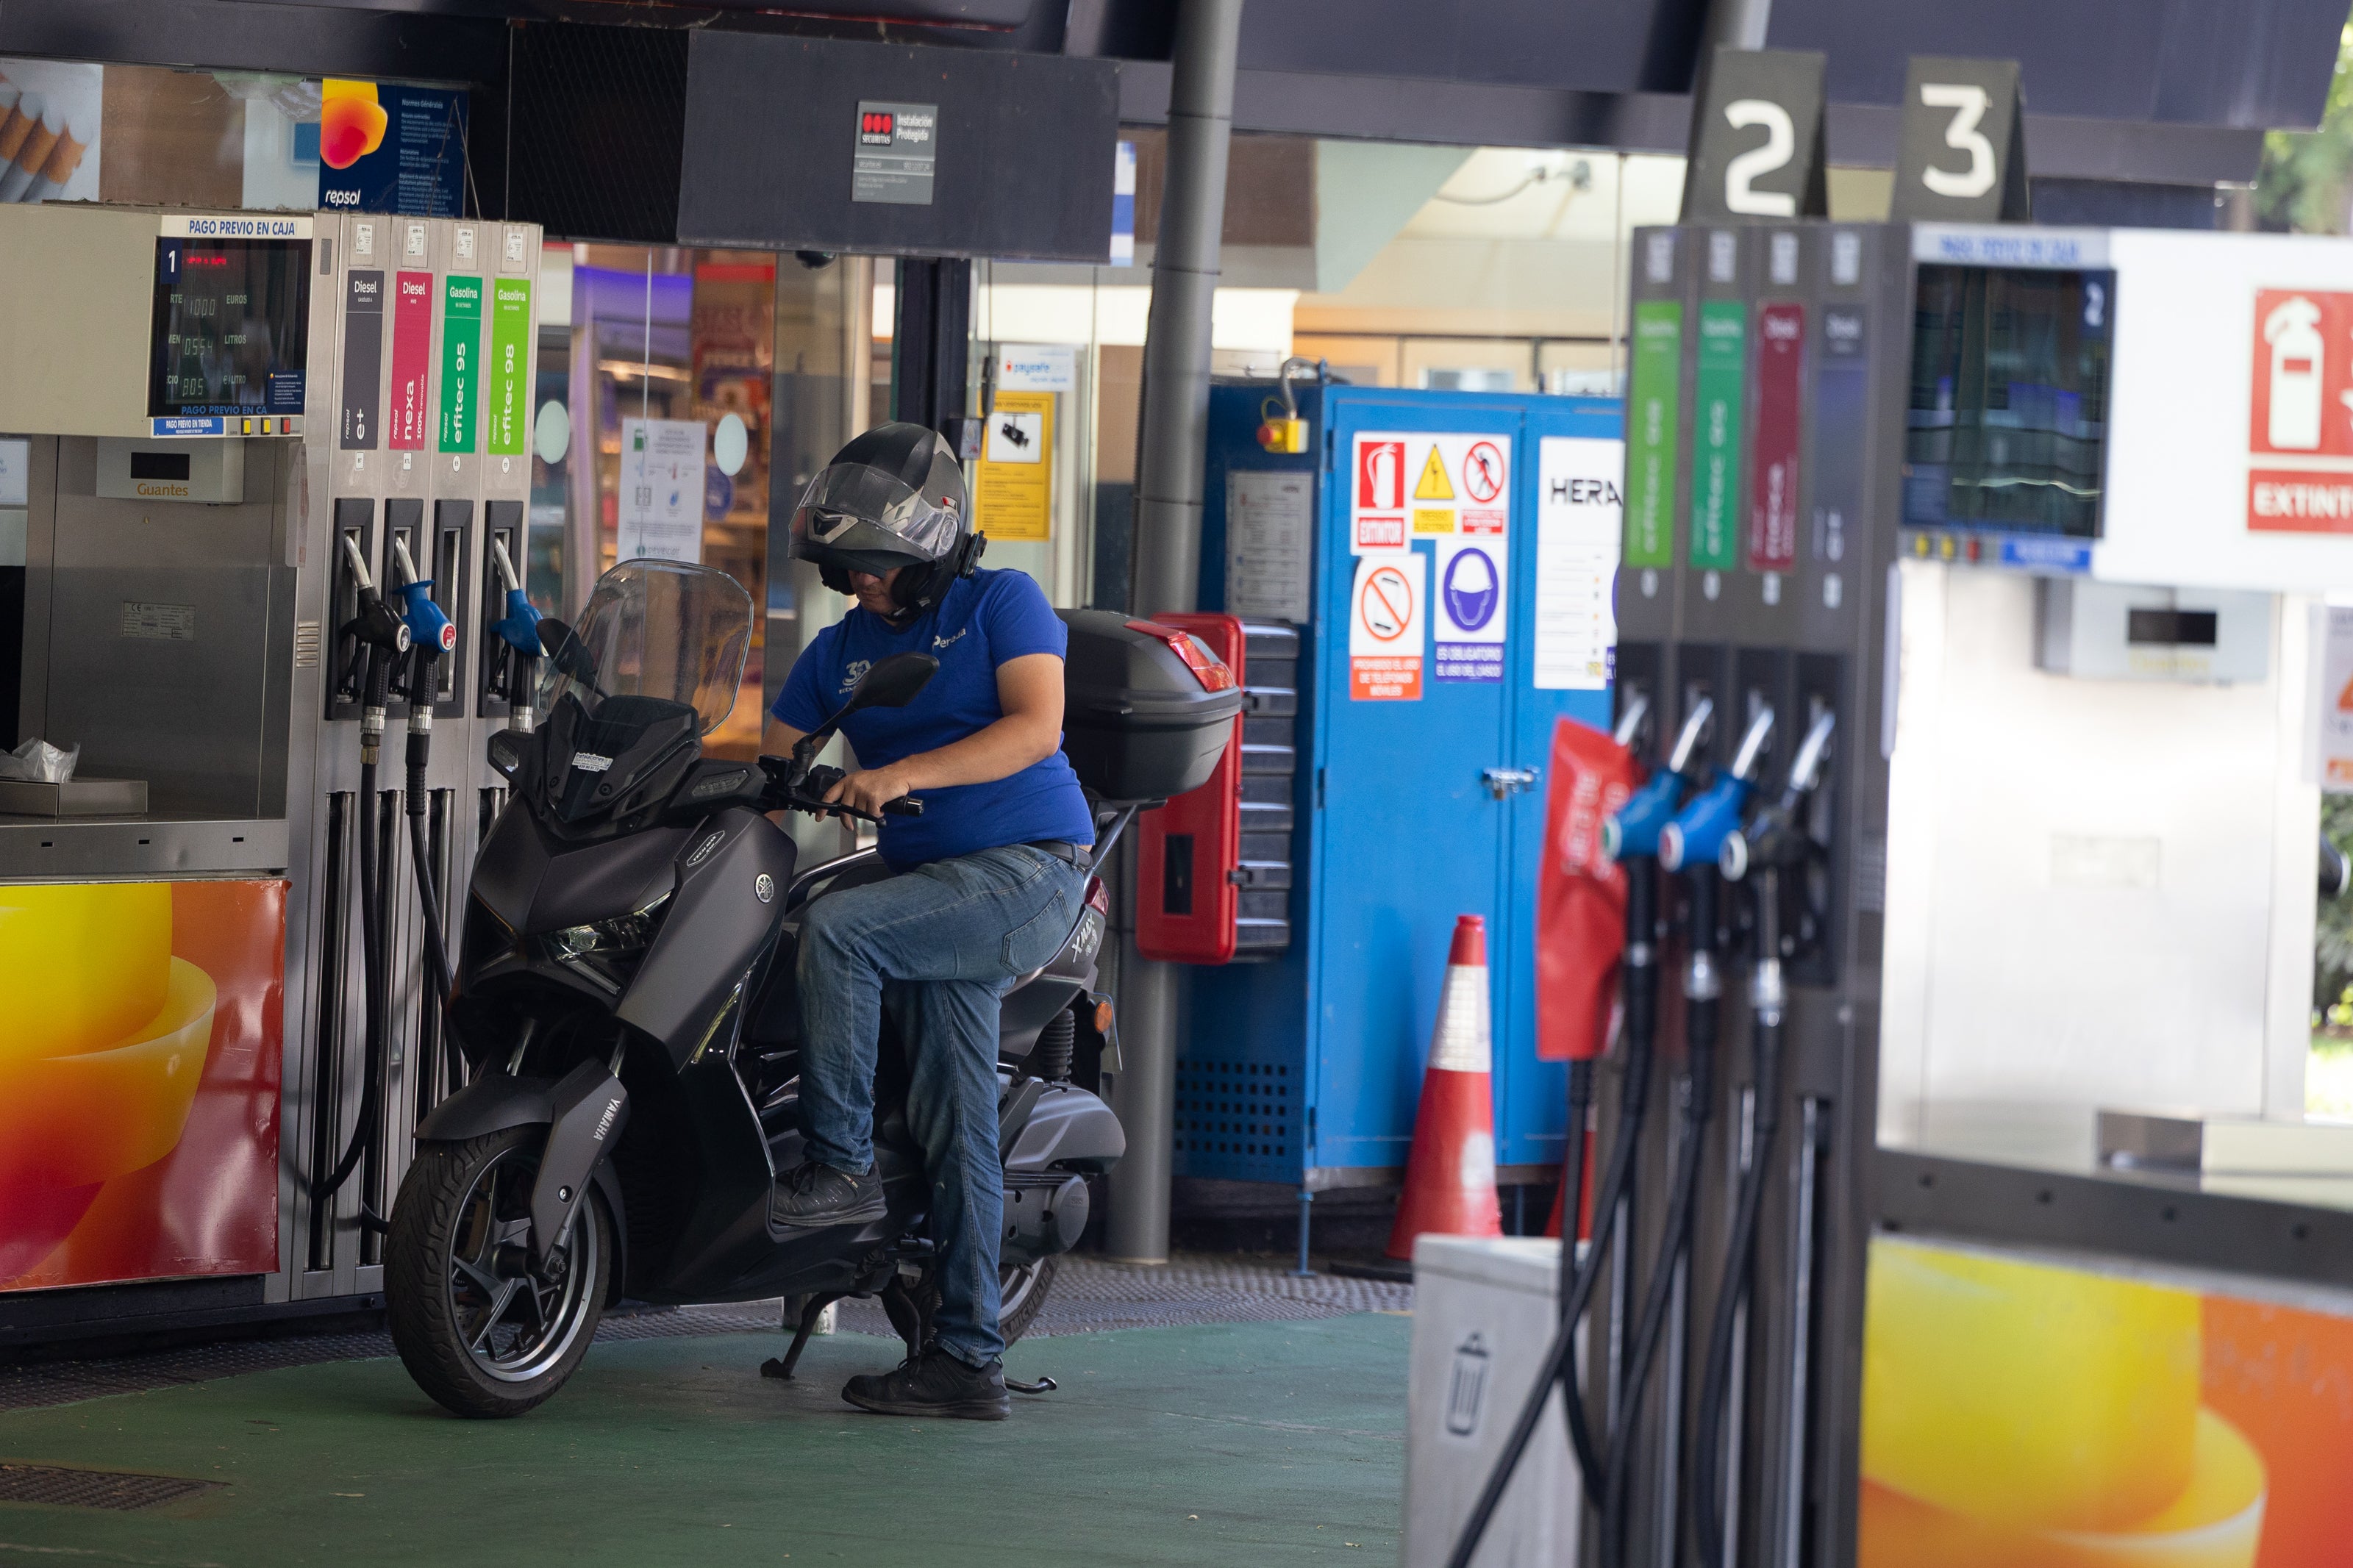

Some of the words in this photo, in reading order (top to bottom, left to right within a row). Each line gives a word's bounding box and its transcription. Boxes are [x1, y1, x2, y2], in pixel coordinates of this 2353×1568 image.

[862, 133, 892, 145] SECURITAS
[896, 126, 929, 143] Protegida
[1920, 82, 1996, 198] 3
[1724, 99, 1795, 218] 2
[325, 189, 361, 207] repsol
[189, 220, 216, 235] PAGO
[219, 221, 254, 235] PREVIO
[257, 222, 269, 235] EN
[272, 222, 295, 236] CAJA
[168, 250, 176, 273] 1
[354, 281, 376, 293] Diesel
[403, 282, 426, 296] Diesel
[449, 286, 478, 299] Gasolina
[498, 289, 526, 302] Gasolina
[226, 295, 248, 305] EUROS
[2085, 281, 2104, 326] 2
[224, 335, 247, 345] LITROS
[456, 343, 466, 371] 95
[505, 343, 515, 373] 98
[182, 406, 206, 415] PAGO
[209, 406, 240, 415] PREVIO
[242, 407, 254, 415] EN
[404, 379, 415, 440] nexa
[454, 377, 465, 444] efitec
[502, 379, 513, 445] efitec
[166, 420, 177, 429] PAGO
[177, 420, 192, 429] PREVIO
[192, 420, 198, 428] EN
[198, 419, 213, 428] TIENDA
[357, 408, 365, 440] e+
[137, 483, 189, 496] Guantes
[1435, 645, 1449, 661] ES
[1449, 645, 1504, 662] OBLIGATORIO
[1393, 659, 1403, 670] EL
[1403, 659, 1420, 670] USO
[1435, 662, 1446, 676] EL
[1462, 663, 1477, 677] DEL
[1359, 672, 1371, 684] DE
[693, 846, 707, 862] TECH
[706, 835, 716, 848] MAX
[593, 1098, 621, 1141] YAMAHA
[1010, 1265, 1052, 1335] MICHELIN
